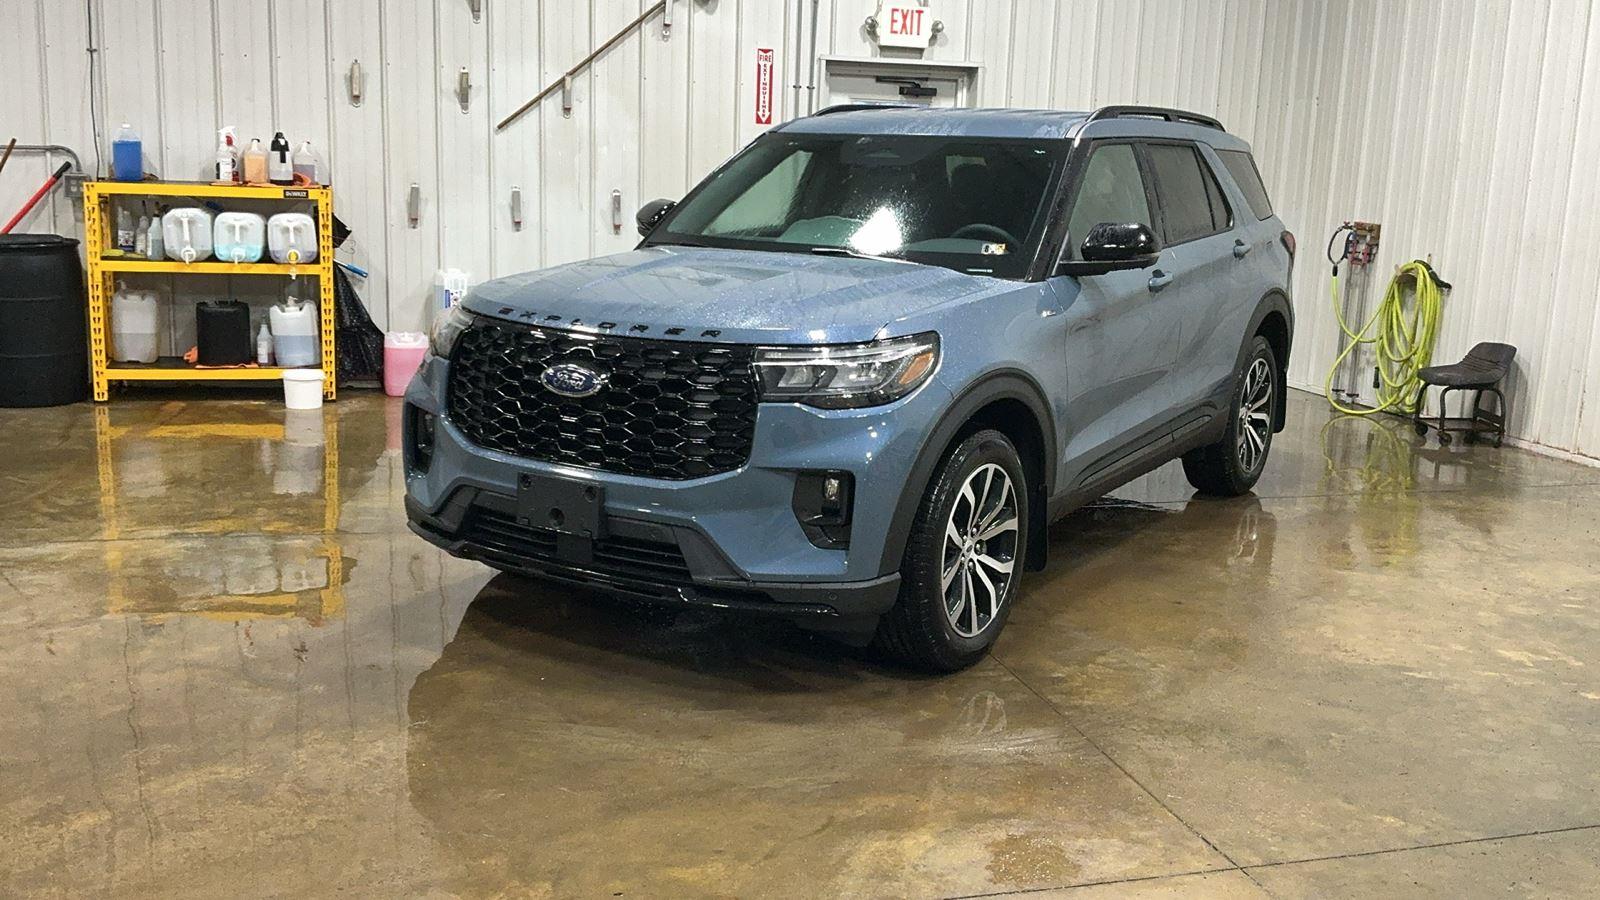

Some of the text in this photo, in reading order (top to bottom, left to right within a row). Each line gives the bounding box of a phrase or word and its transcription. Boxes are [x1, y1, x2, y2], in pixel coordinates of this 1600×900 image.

[890, 8, 924, 36] EXIT
[498, 307, 722, 338] EXPLORER
[552, 370, 586, 390] Ford
